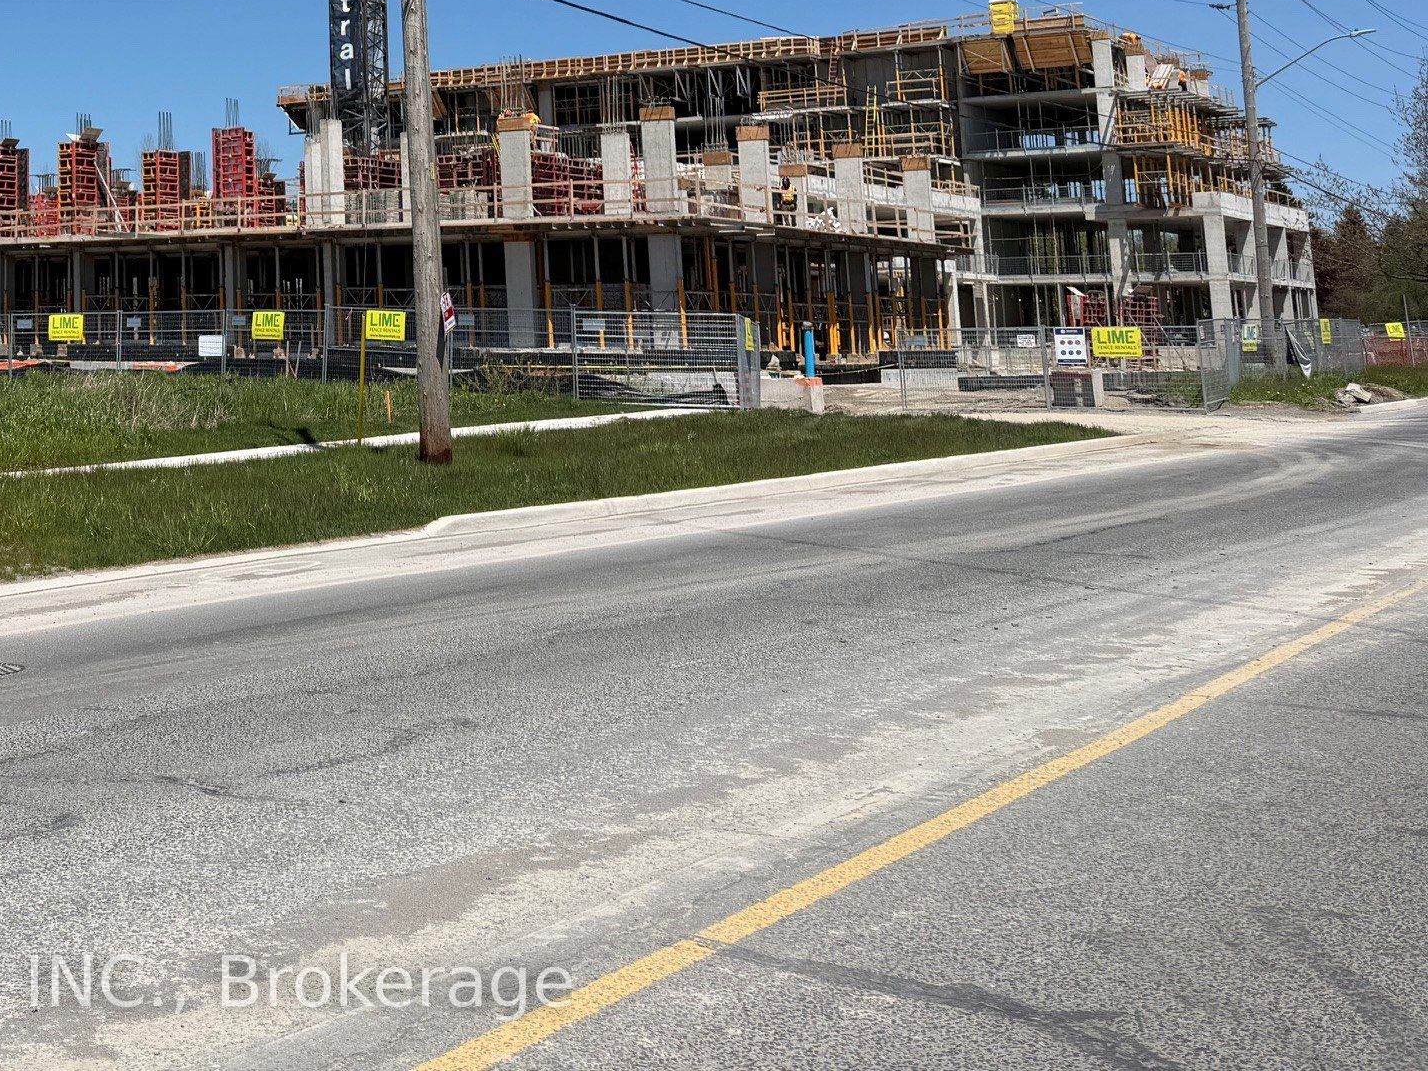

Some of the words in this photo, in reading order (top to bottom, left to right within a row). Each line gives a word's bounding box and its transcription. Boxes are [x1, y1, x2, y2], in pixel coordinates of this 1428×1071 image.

[52, 316, 80, 330] LIME
[255, 313, 281, 327] LIME
[370, 312, 401, 328] LIME
[1096, 330, 1136, 344] LIME
